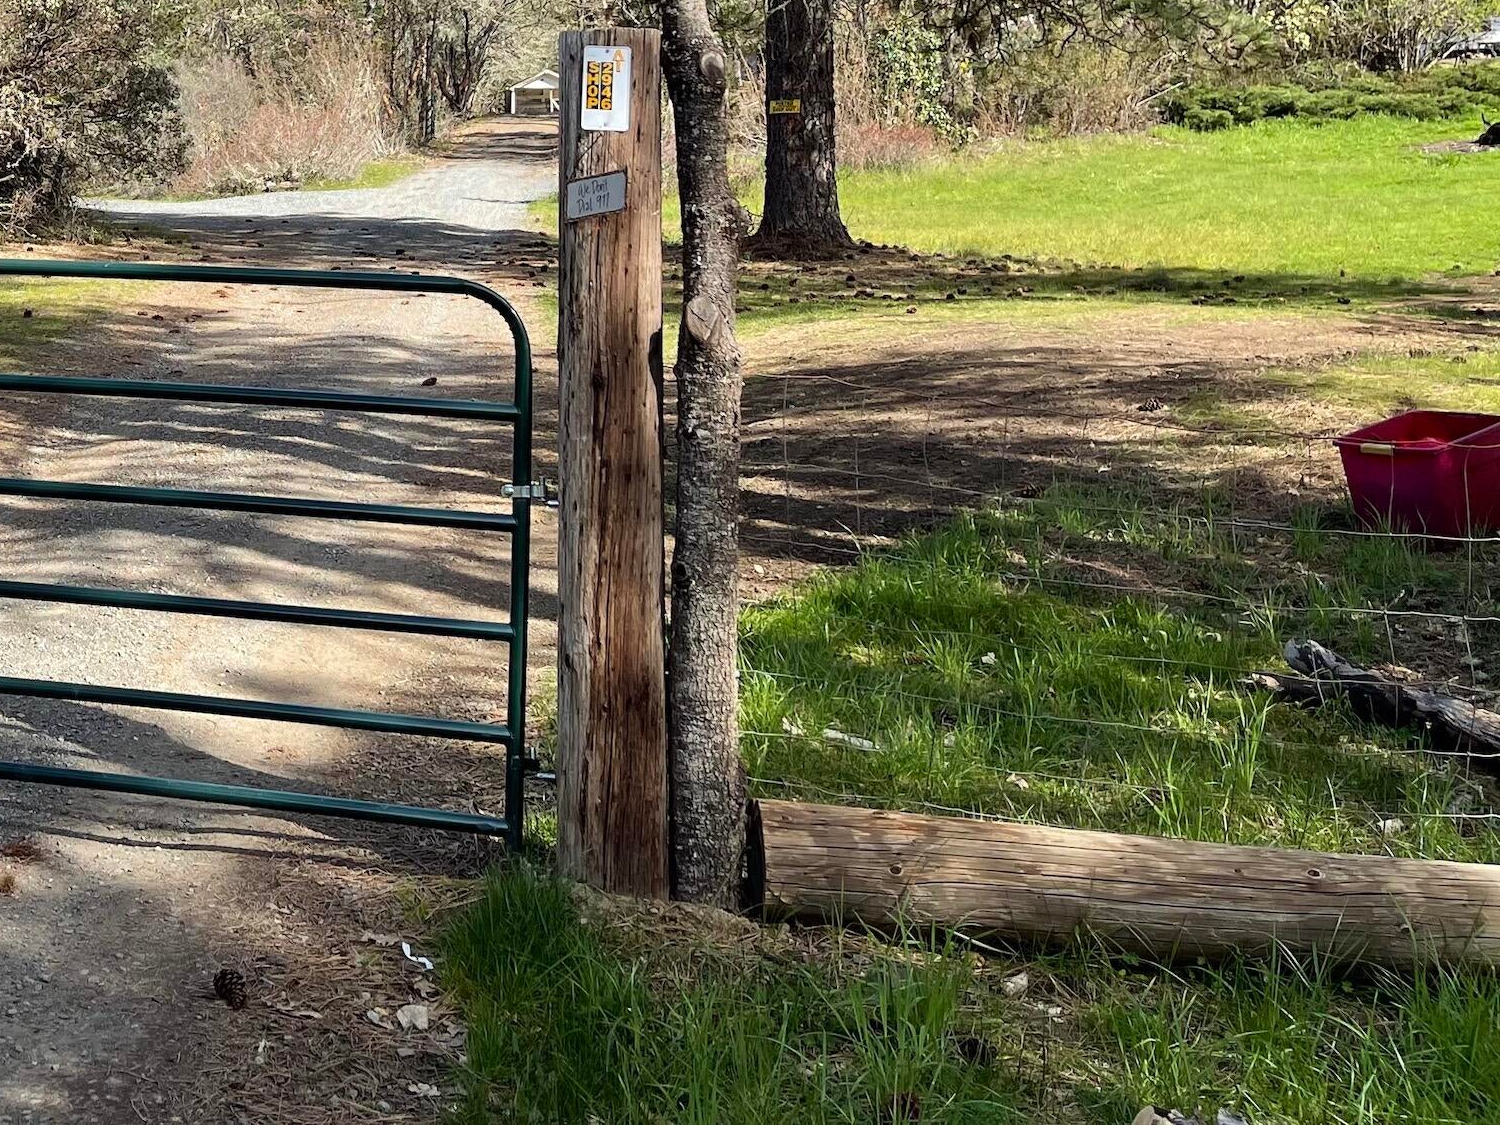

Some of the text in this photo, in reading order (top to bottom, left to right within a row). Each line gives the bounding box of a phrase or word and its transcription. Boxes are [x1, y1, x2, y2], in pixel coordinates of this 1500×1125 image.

[587, 61, 600, 109] SHOP
[601, 62, 613, 110] 2946
[596, 192, 609, 209] 911
